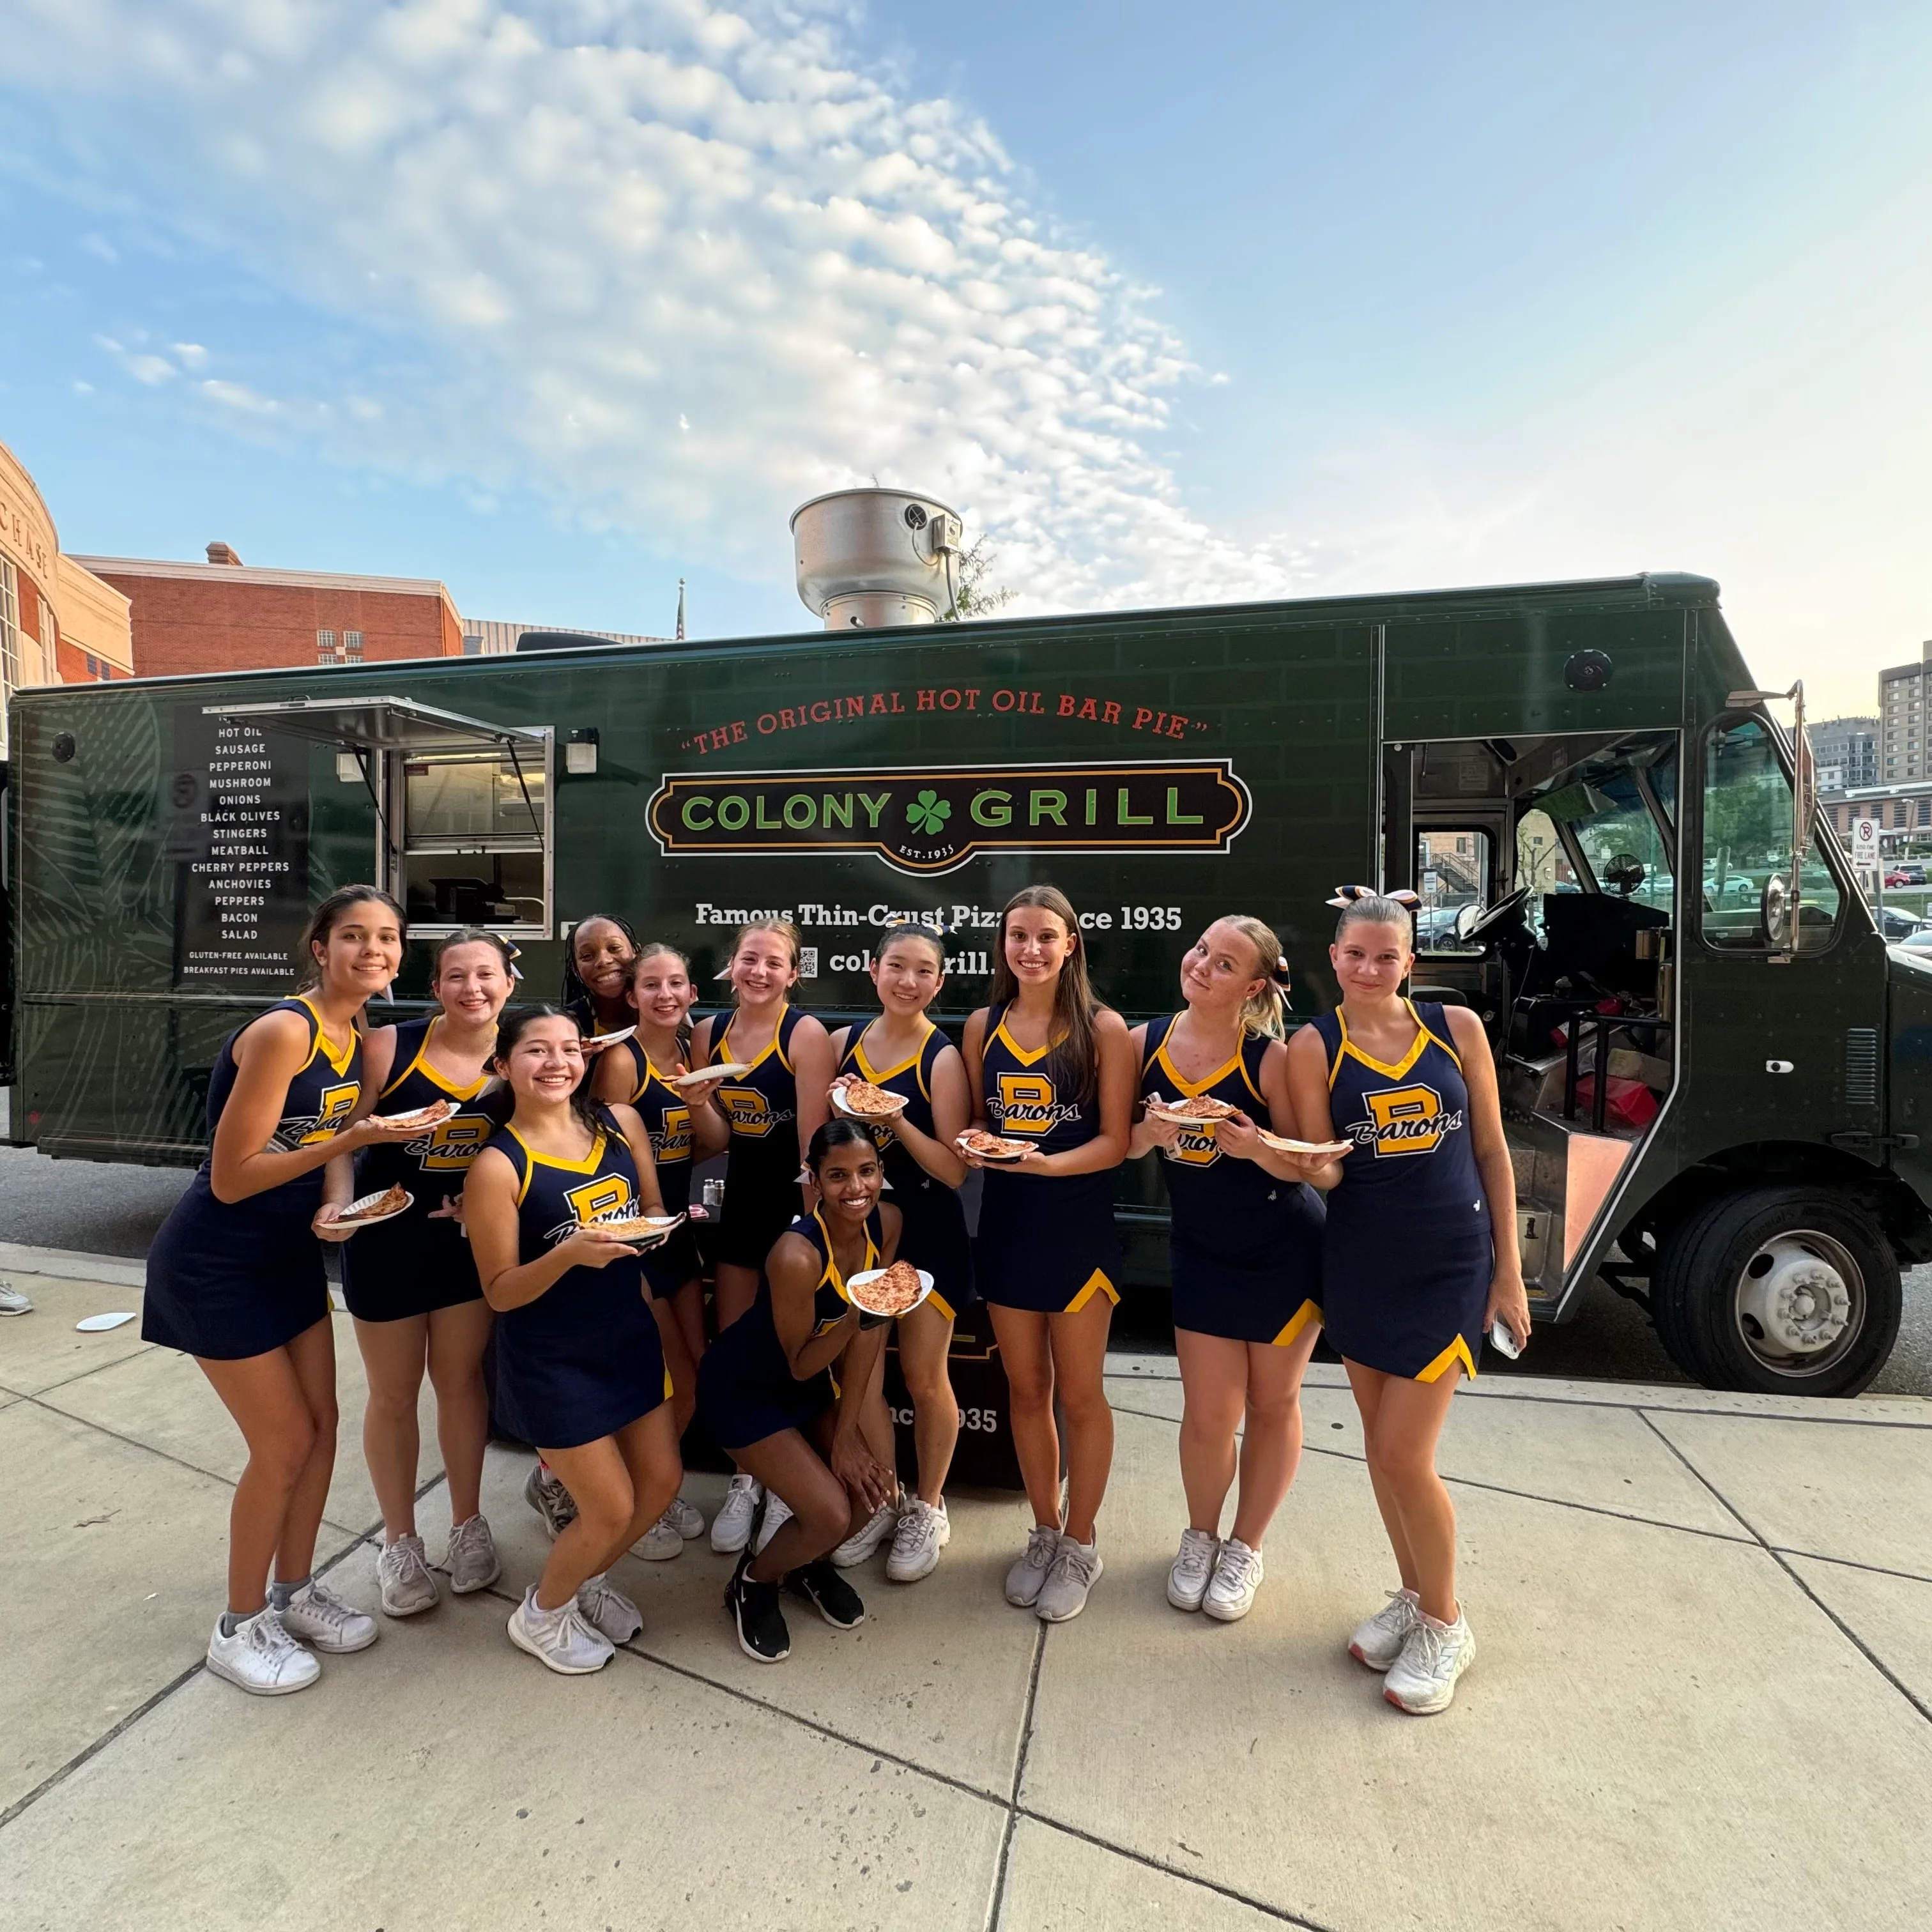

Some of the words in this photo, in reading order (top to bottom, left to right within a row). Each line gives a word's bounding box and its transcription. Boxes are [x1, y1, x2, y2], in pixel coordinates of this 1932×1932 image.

[682, 721, 747, 755] “THE
[757, 692, 905, 734] ORIGINAL
[916, 689, 981, 711] HOT
[992, 690, 1045, 714] OIL
[1057, 695, 1122, 725] BAR
[218, 728, 240, 738] HOT
[244, 727, 262, 737] OIL
[215, 744, 266, 755] SAUSAGE
[210, 760, 271, 772] PEPPERONI
[210, 778, 271, 788] MUSHROOM
[219, 795, 261, 805] ONIONS
[682, 793, 892, 831] COLONY
[970, 787, 1204, 827] GRILL
[201, 813, 236, 822] BLACK
[240, 811, 280, 821] OLIVES
[213, 829, 266, 839] STINGERS
[211, 846, 268, 855] MEATBALL
[192, 863, 234, 872] CHERRY
[239, 862, 289, 871] PEPPERS
[208, 880, 271, 889] ANCHOVIES
[215, 896, 264, 905] PEPPERS
[221, 914, 257, 923] BACON
[1121, 907, 1181, 930] 1935
[222, 930, 257, 939] SALAD
[189, 951, 241, 960] GLUTEN-FREE
[986, 1096, 1082, 1123] Barons
[722, 1108, 795, 1126] arons
[1345, 1109, 1462, 1145] Barons
